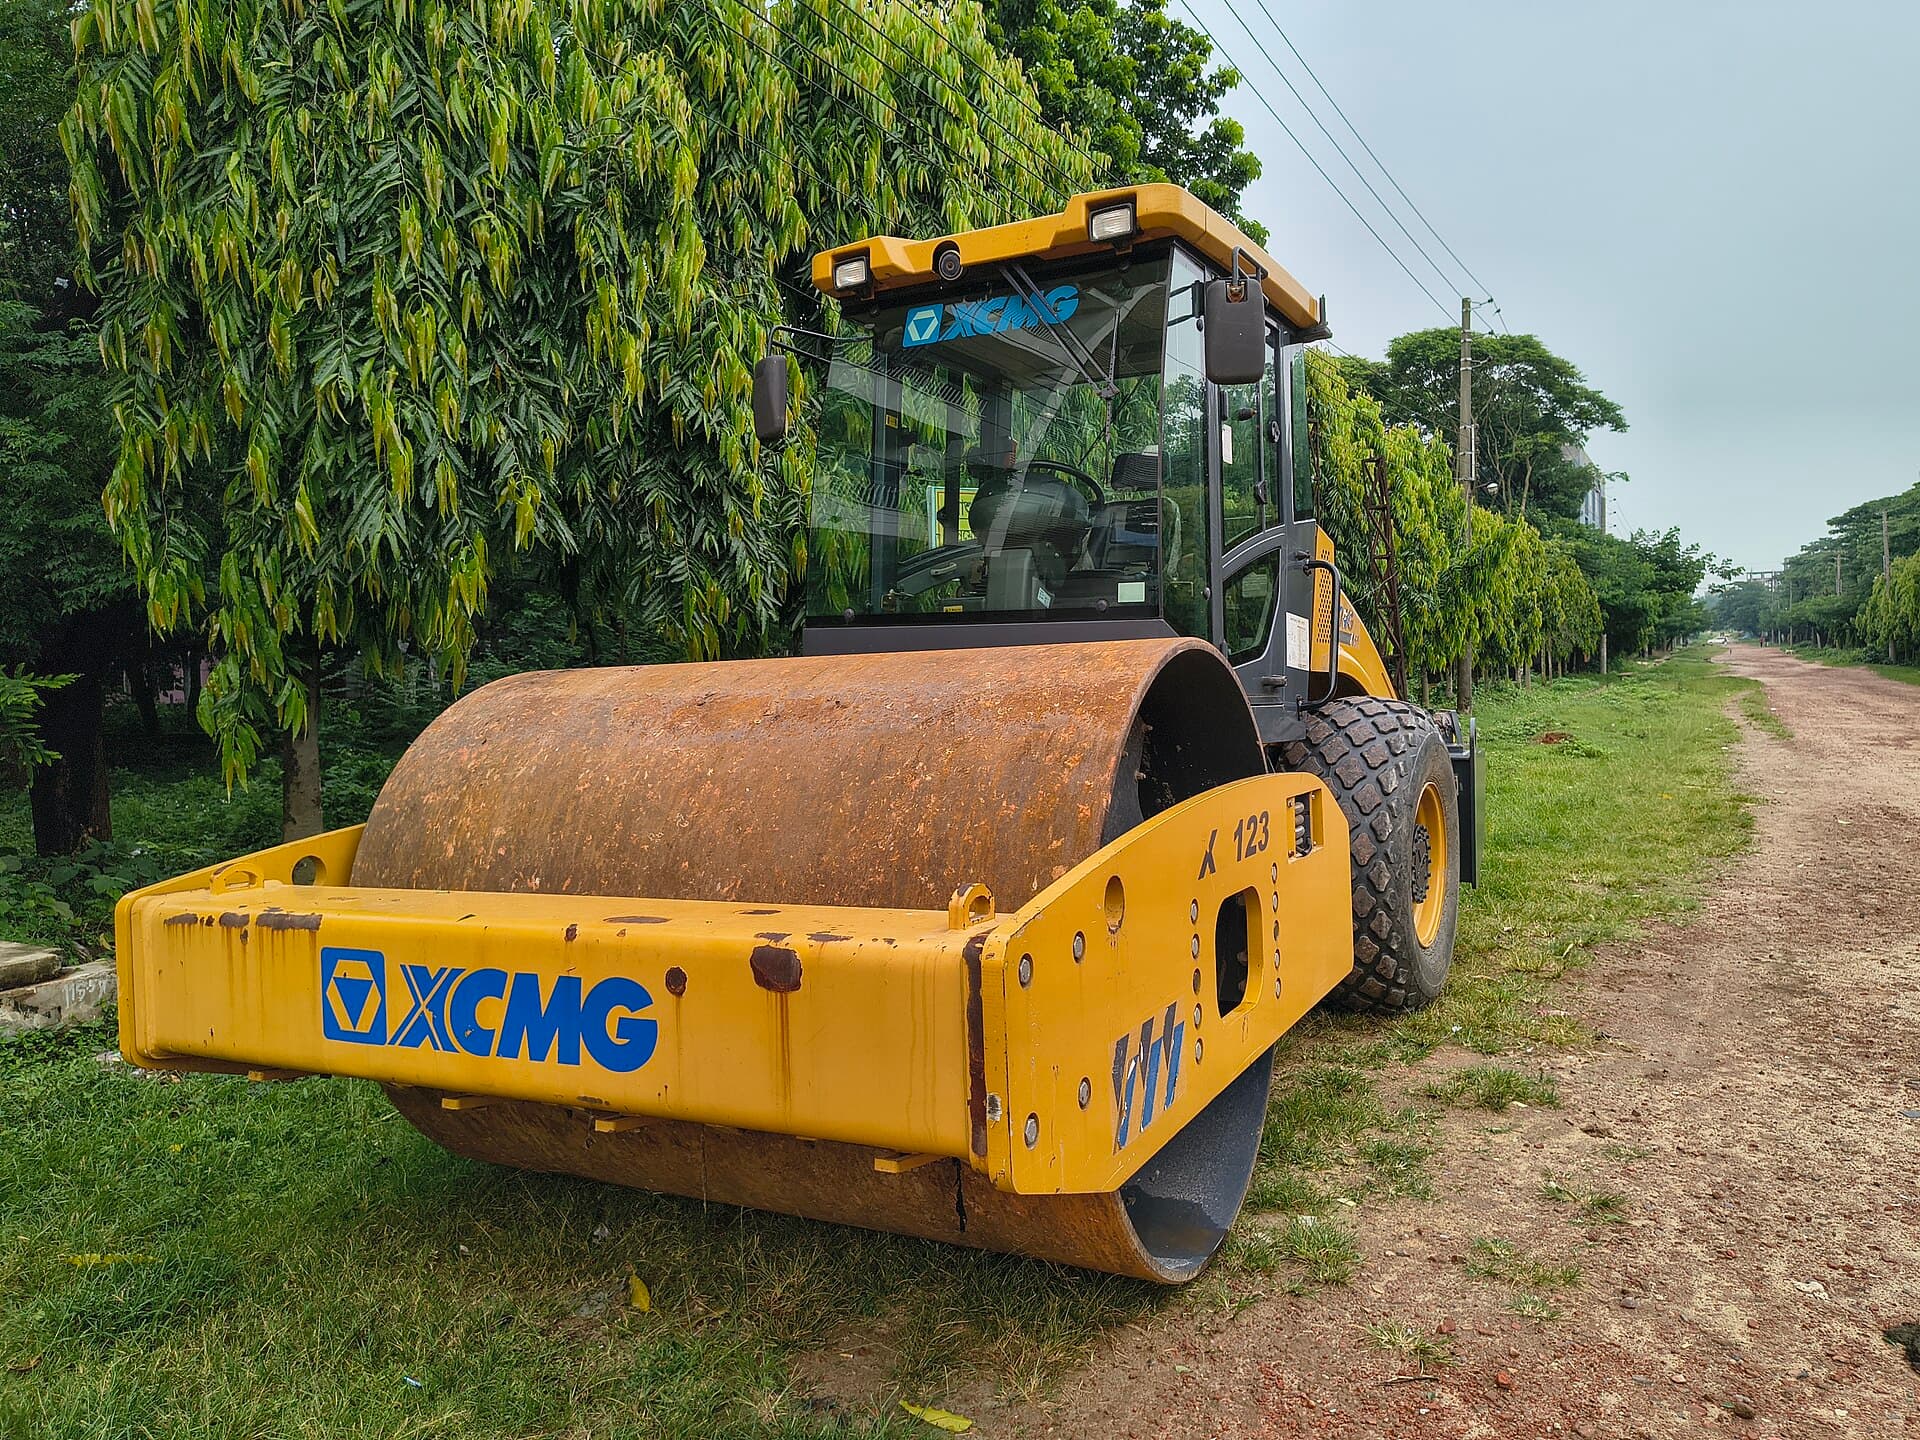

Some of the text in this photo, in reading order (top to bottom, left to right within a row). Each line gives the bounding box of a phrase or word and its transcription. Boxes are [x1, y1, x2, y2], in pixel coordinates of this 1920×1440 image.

[938, 285, 1079, 342] XCMG
[1233, 810, 1269, 862] 123
[388, 964, 659, 1073] XCMG
